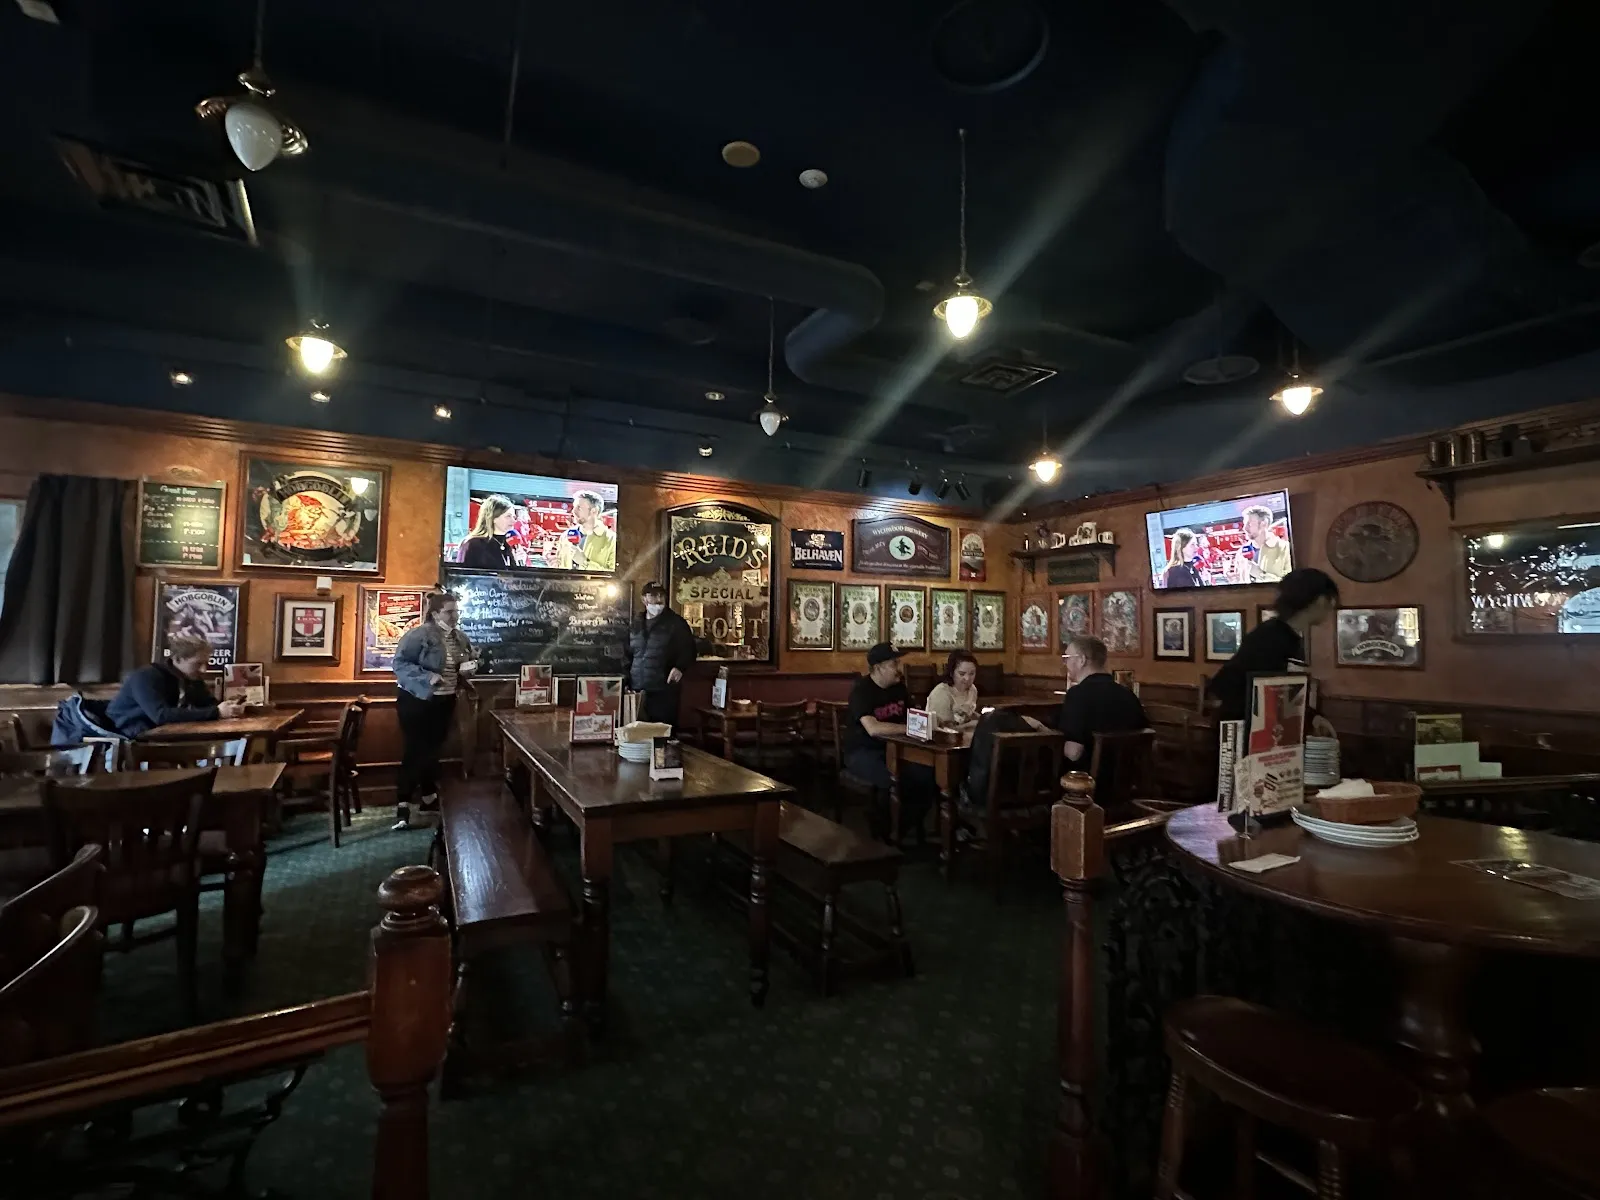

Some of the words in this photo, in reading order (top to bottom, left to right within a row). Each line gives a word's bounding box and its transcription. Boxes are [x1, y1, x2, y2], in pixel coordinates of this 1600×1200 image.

[794, 546, 843, 563] BELHAVEN
[174, 592, 229, 607] HOBGOBLIN
[690, 586, 754, 600] SPECIAL
